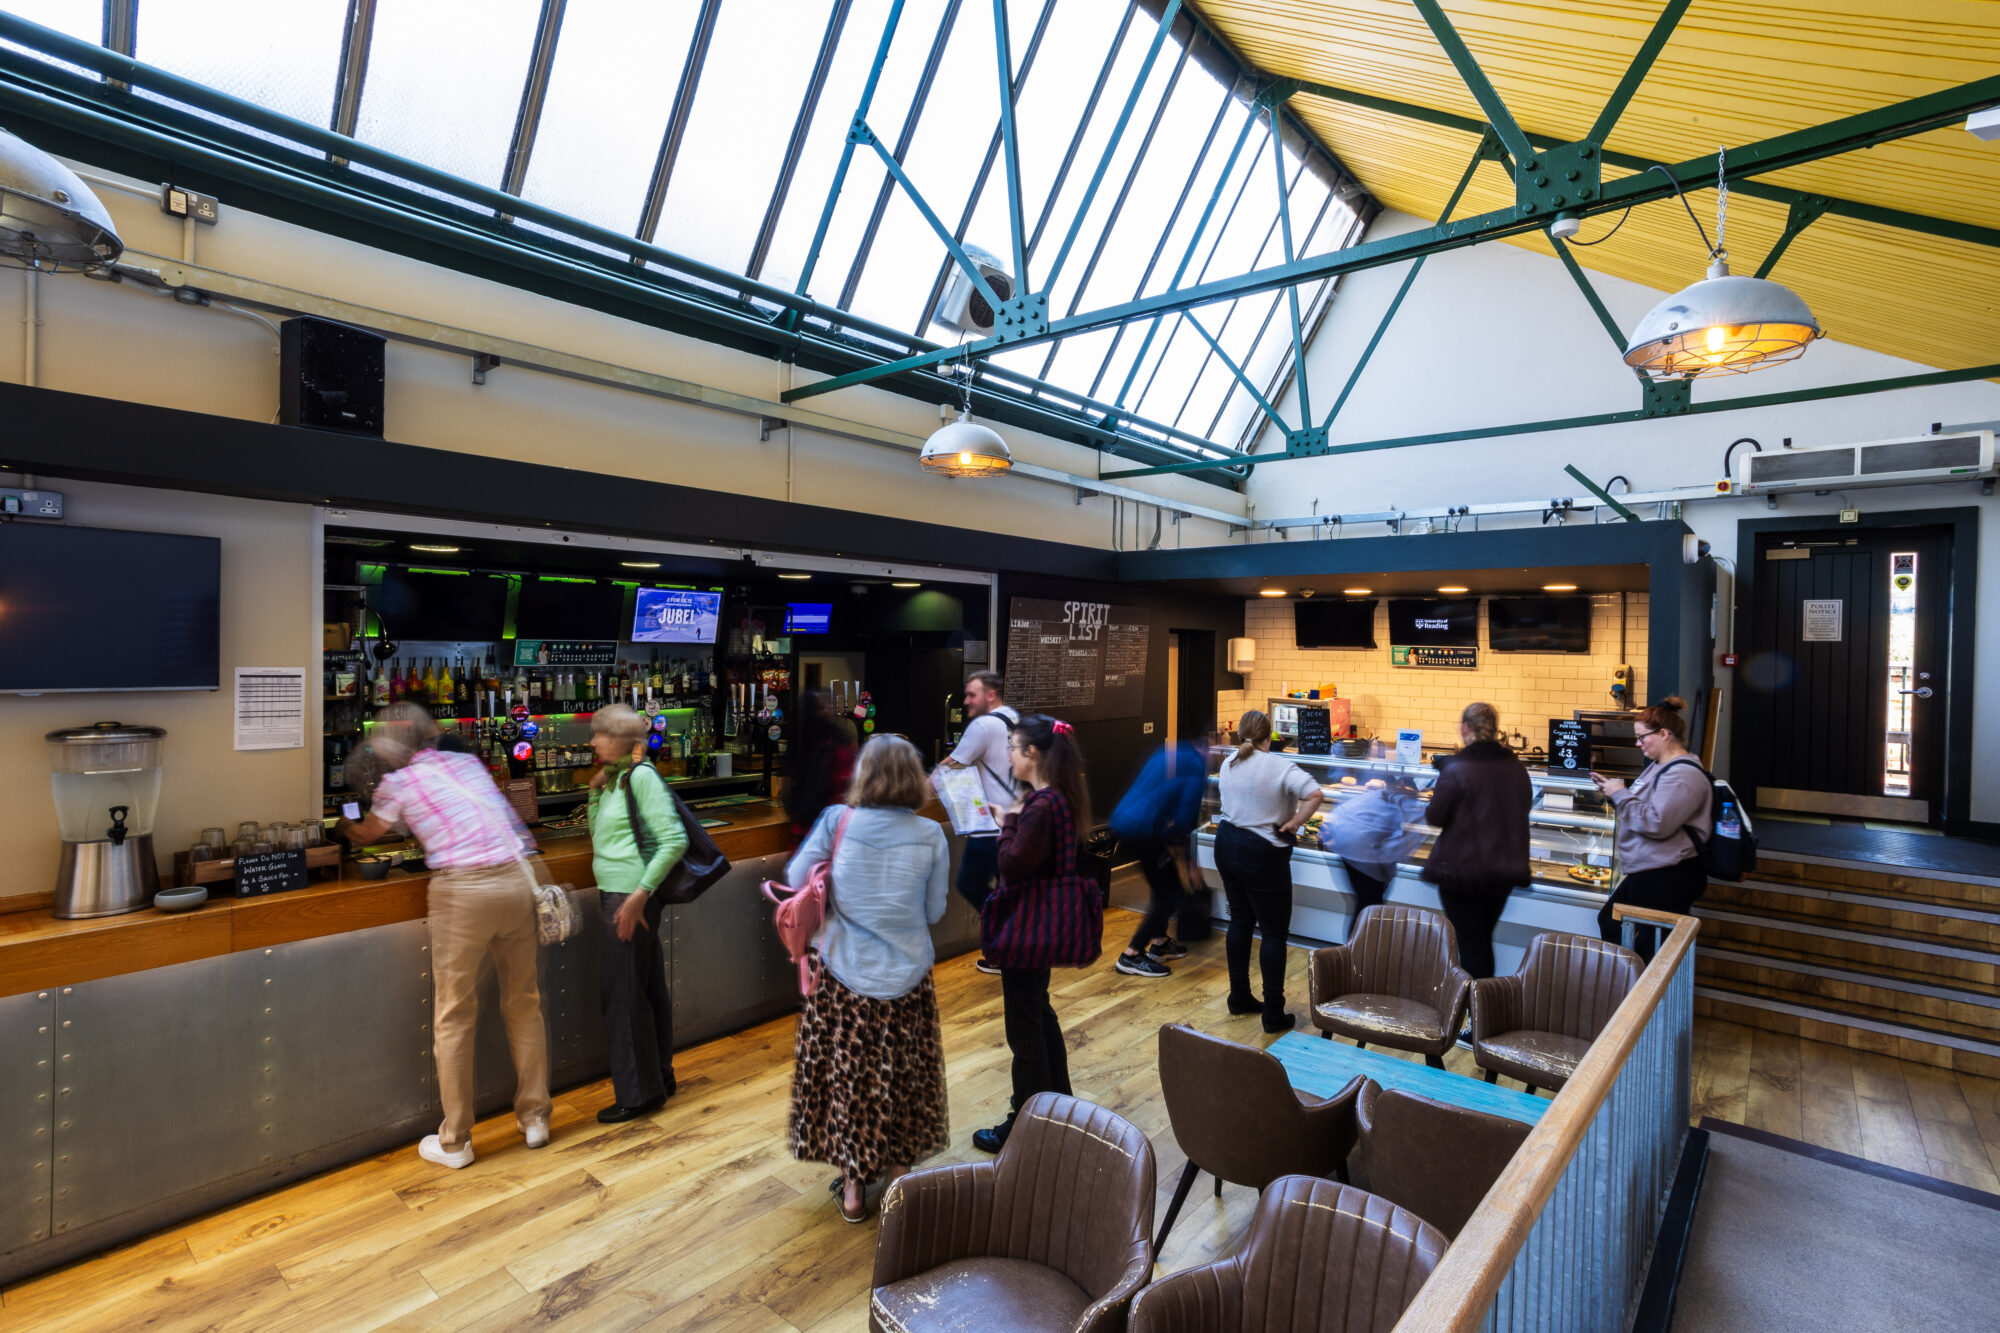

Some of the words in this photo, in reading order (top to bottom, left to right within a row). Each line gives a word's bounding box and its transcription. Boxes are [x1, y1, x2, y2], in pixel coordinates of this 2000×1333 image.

[658, 608, 695, 624] JUBEL
[1063, 601, 1110, 625] SPIRIT
[1040, 636, 1062, 644] WHISKEY
[1069, 623, 1101, 641] LIST
